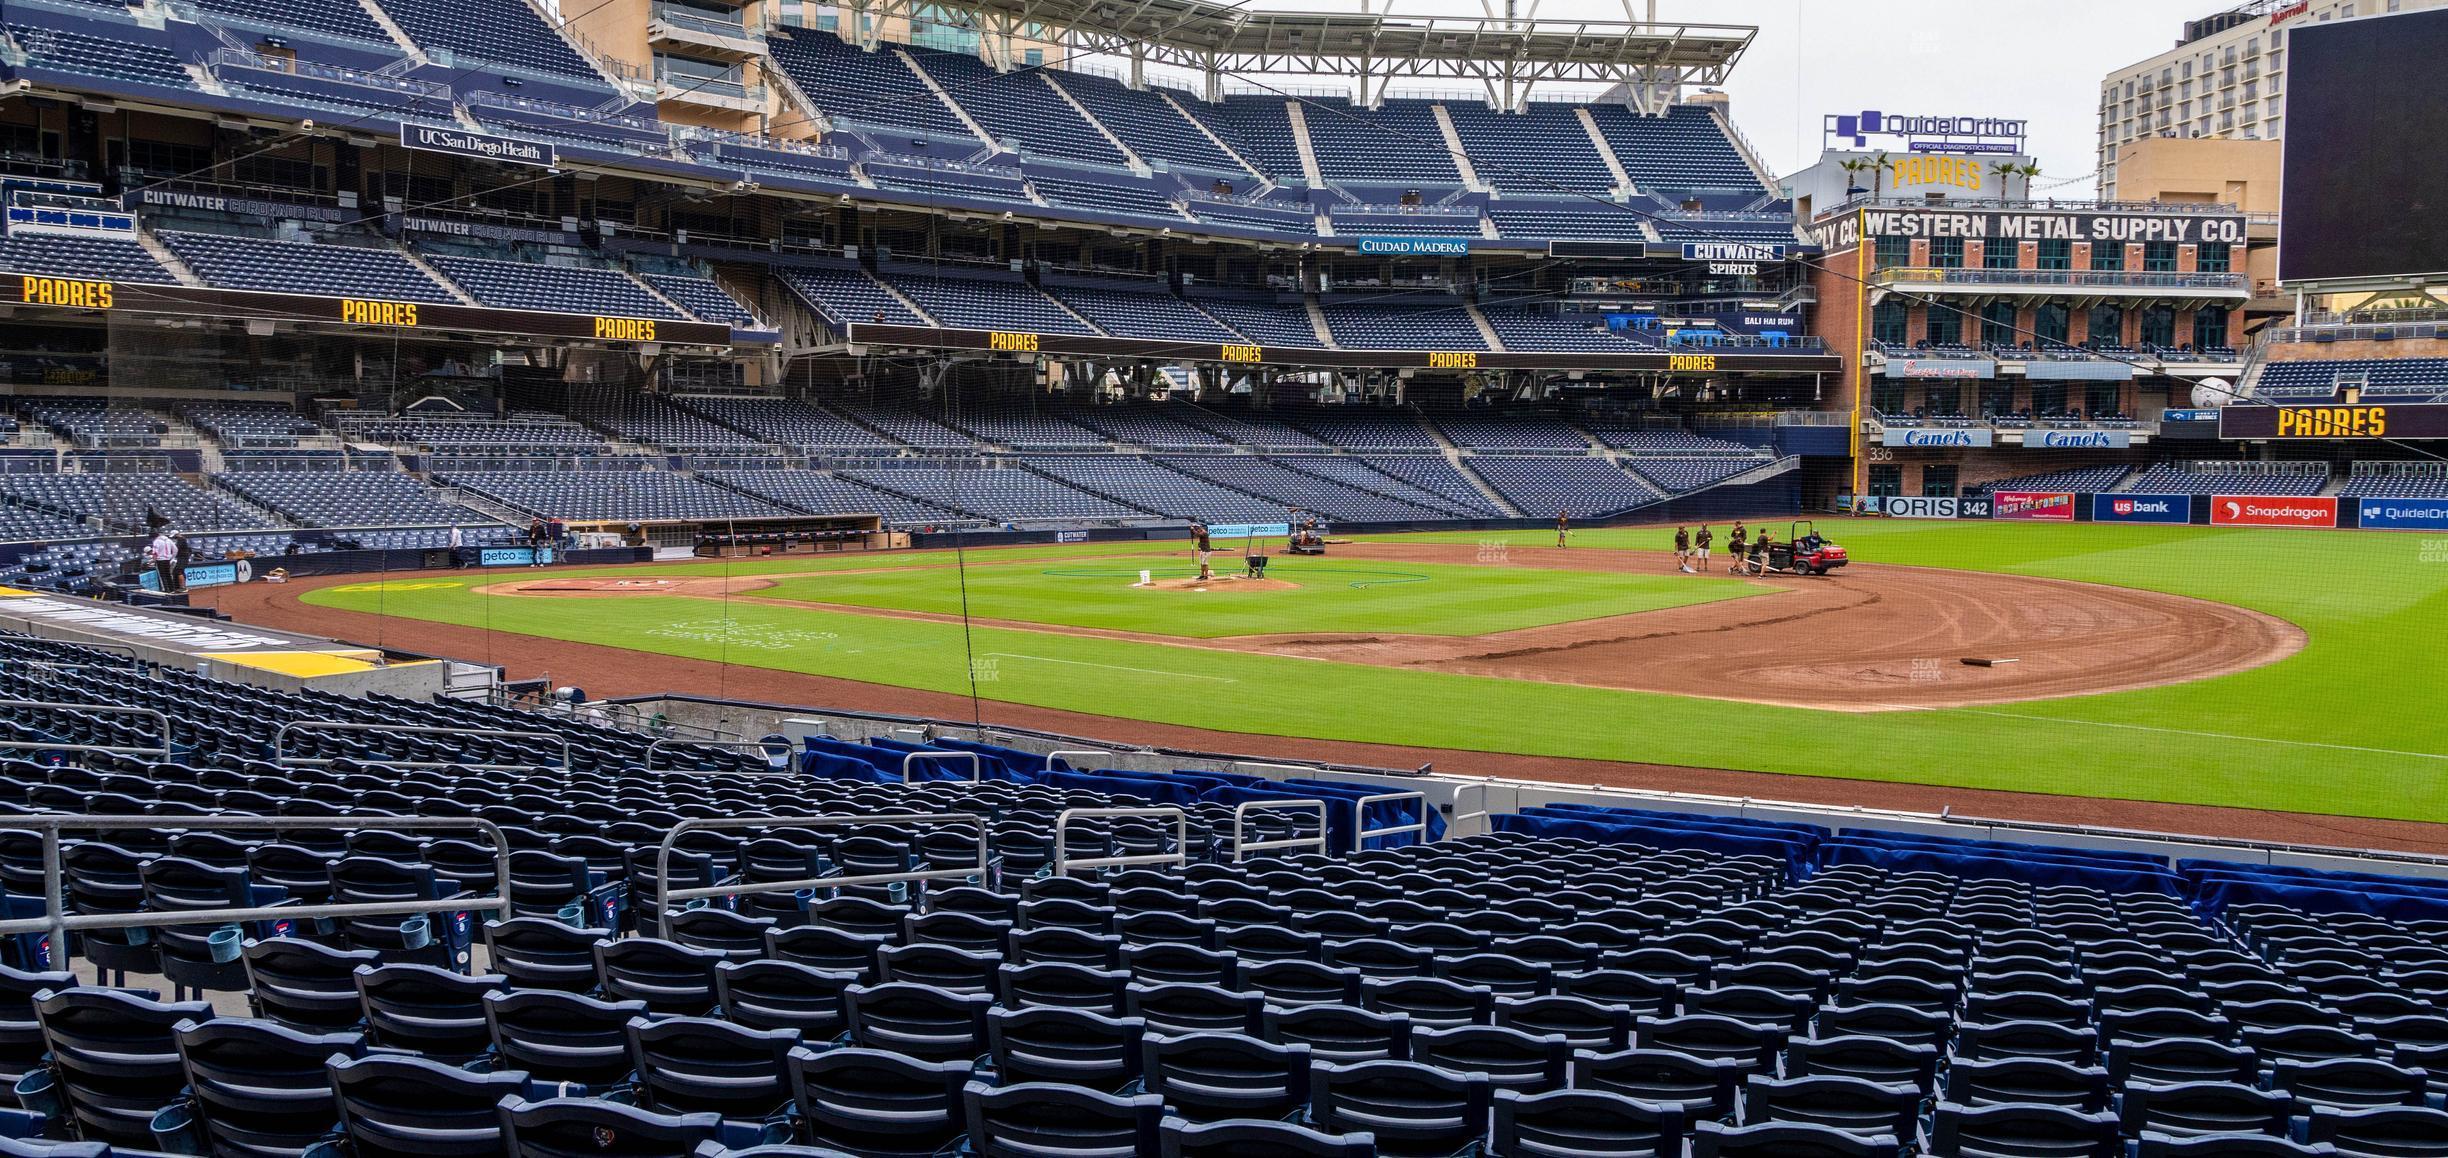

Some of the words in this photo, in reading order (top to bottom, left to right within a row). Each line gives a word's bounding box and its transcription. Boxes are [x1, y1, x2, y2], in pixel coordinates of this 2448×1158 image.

[1888, 115, 2019, 137] QuidelOrtho
[419, 129, 441, 145] UC
[441, 133, 466, 149] San
[466, 136, 501, 156] Diego
[502, 142, 541, 160] Health
[1893, 155, 1981, 190] PADRES
[229, 199, 305, 219] CORONADO
[1840, 217, 1860, 246] CO.
[1864, 212, 1987, 237] WESTERN
[2001, 214, 2085, 240] METAL
[2092, 217, 2191, 242] SUPPLY
[2201, 219, 2244, 243] CO.
[1362, 240, 1410, 252] CIUDAD
[1413, 241, 1466, 253] MADERAS
[1694, 244, 1774, 260] CUTWATER
[1709, 264, 1758, 275] SPIRITS
[23, 276, 113, 308] PADRES
[342, 299, 417, 326] PADRES
[595, 317, 656, 341] PADRES
[1744, 317, 1762, 325] BALI
[1777, 318, 1794, 326] RUM
[990, 332, 1038, 351] PADRES
[1222, 345, 1261, 362] PADRES
[1430, 352, 1476, 368] PADRES
[1669, 355, 1715, 370] PADRES
[2277, 407, 2386, 436] PADRES
[1904, 430, 1973, 446] Canel's
[2044, 431, 2110, 447] Canel's
[1870, 447, 1893, 461] 336
[1889, 498, 1955, 517] ORIS
[1963, 502, 1987, 516] 342
[2246, 504, 2328, 519] Snapdragon
[484, 551, 516, 563] petco
[186, 569, 207, 581] etco
